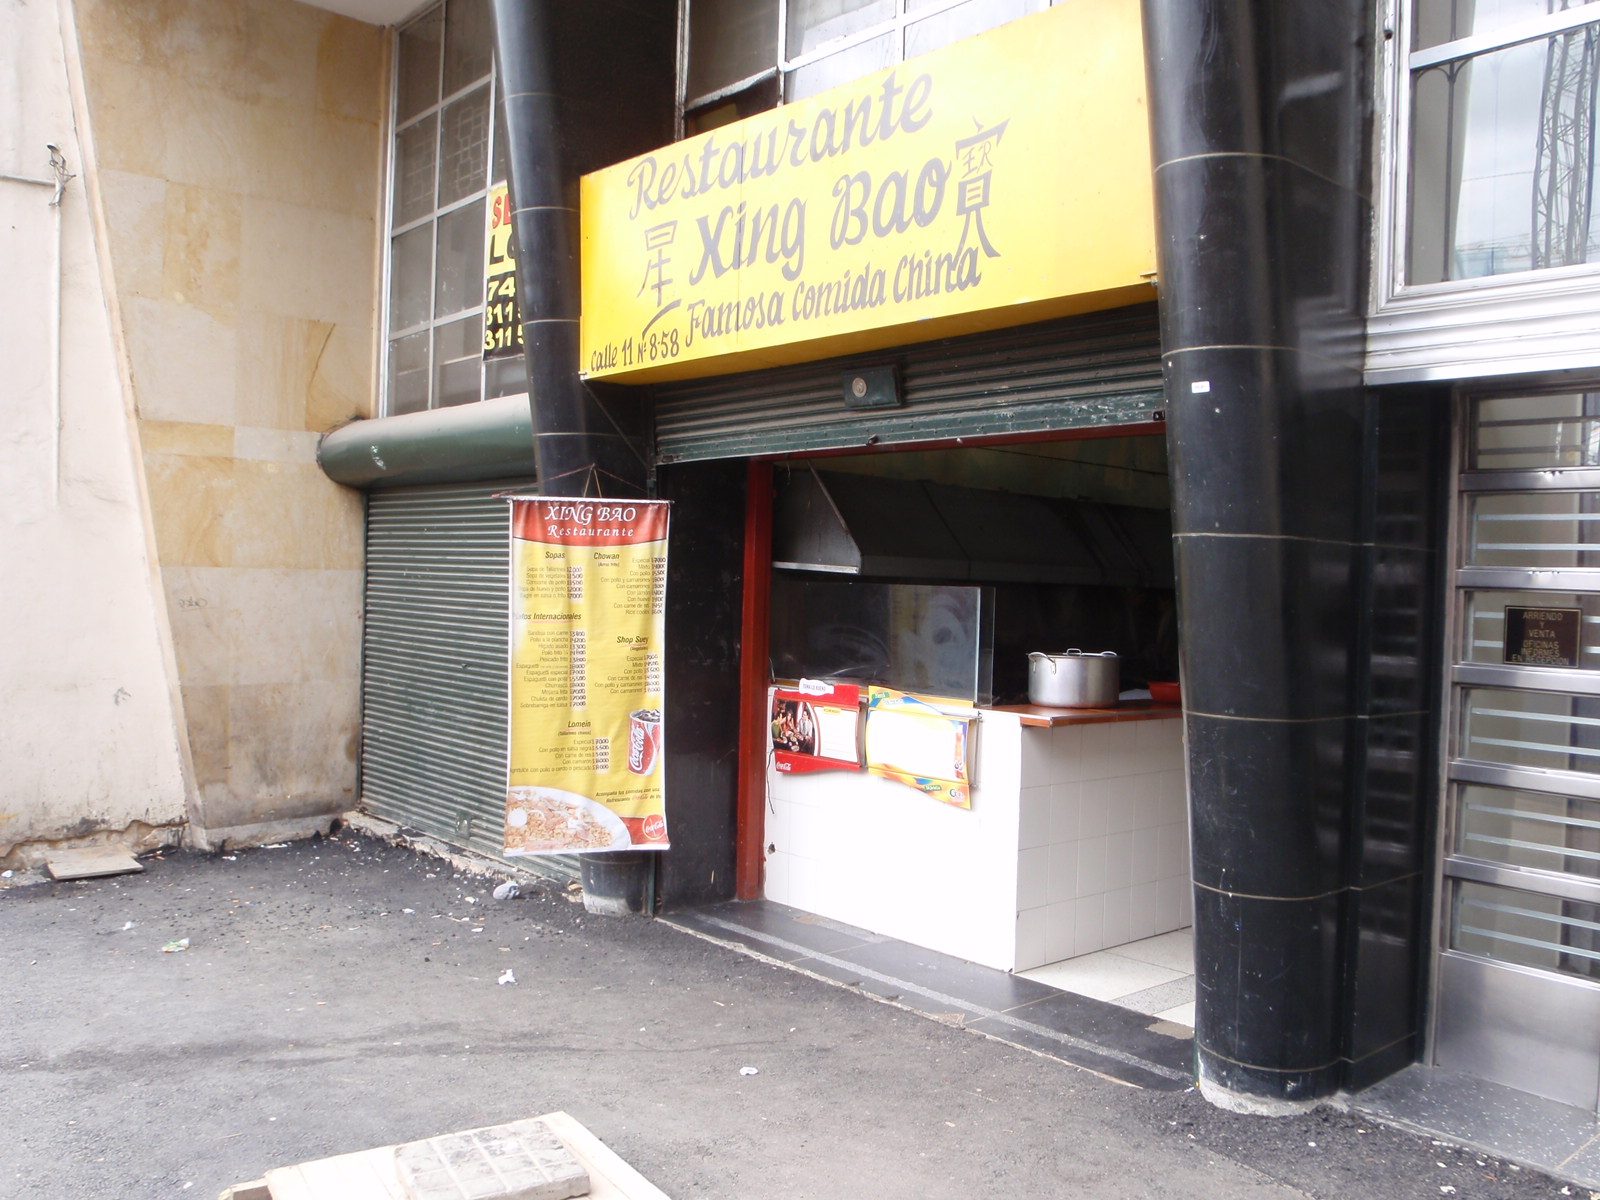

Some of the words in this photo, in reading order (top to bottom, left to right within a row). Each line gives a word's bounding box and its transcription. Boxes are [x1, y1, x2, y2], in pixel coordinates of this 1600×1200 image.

[626, 73, 933, 220] Restaurante
[689, 196, 808, 287] Xing
[829, 156, 952, 251] Bao
[685, 290, 787, 348] Famosa
[792, 262, 887, 322] Comida
[894, 245, 983, 304] China
[621, 336, 634, 367] 11
[545, 504, 593, 524] XING
[596, 505, 637, 523] BAO
[547, 524, 635, 539] Restaurante
[545, 551, 567, 560] Sopas
[593, 551, 621, 560] Chowan
[533, 612, 582, 620] Internacionales
[1522, 611, 1564, 621] ARRIENDO
[1528, 630, 1556, 638] VENTA
[616, 636, 634, 645] Shop
